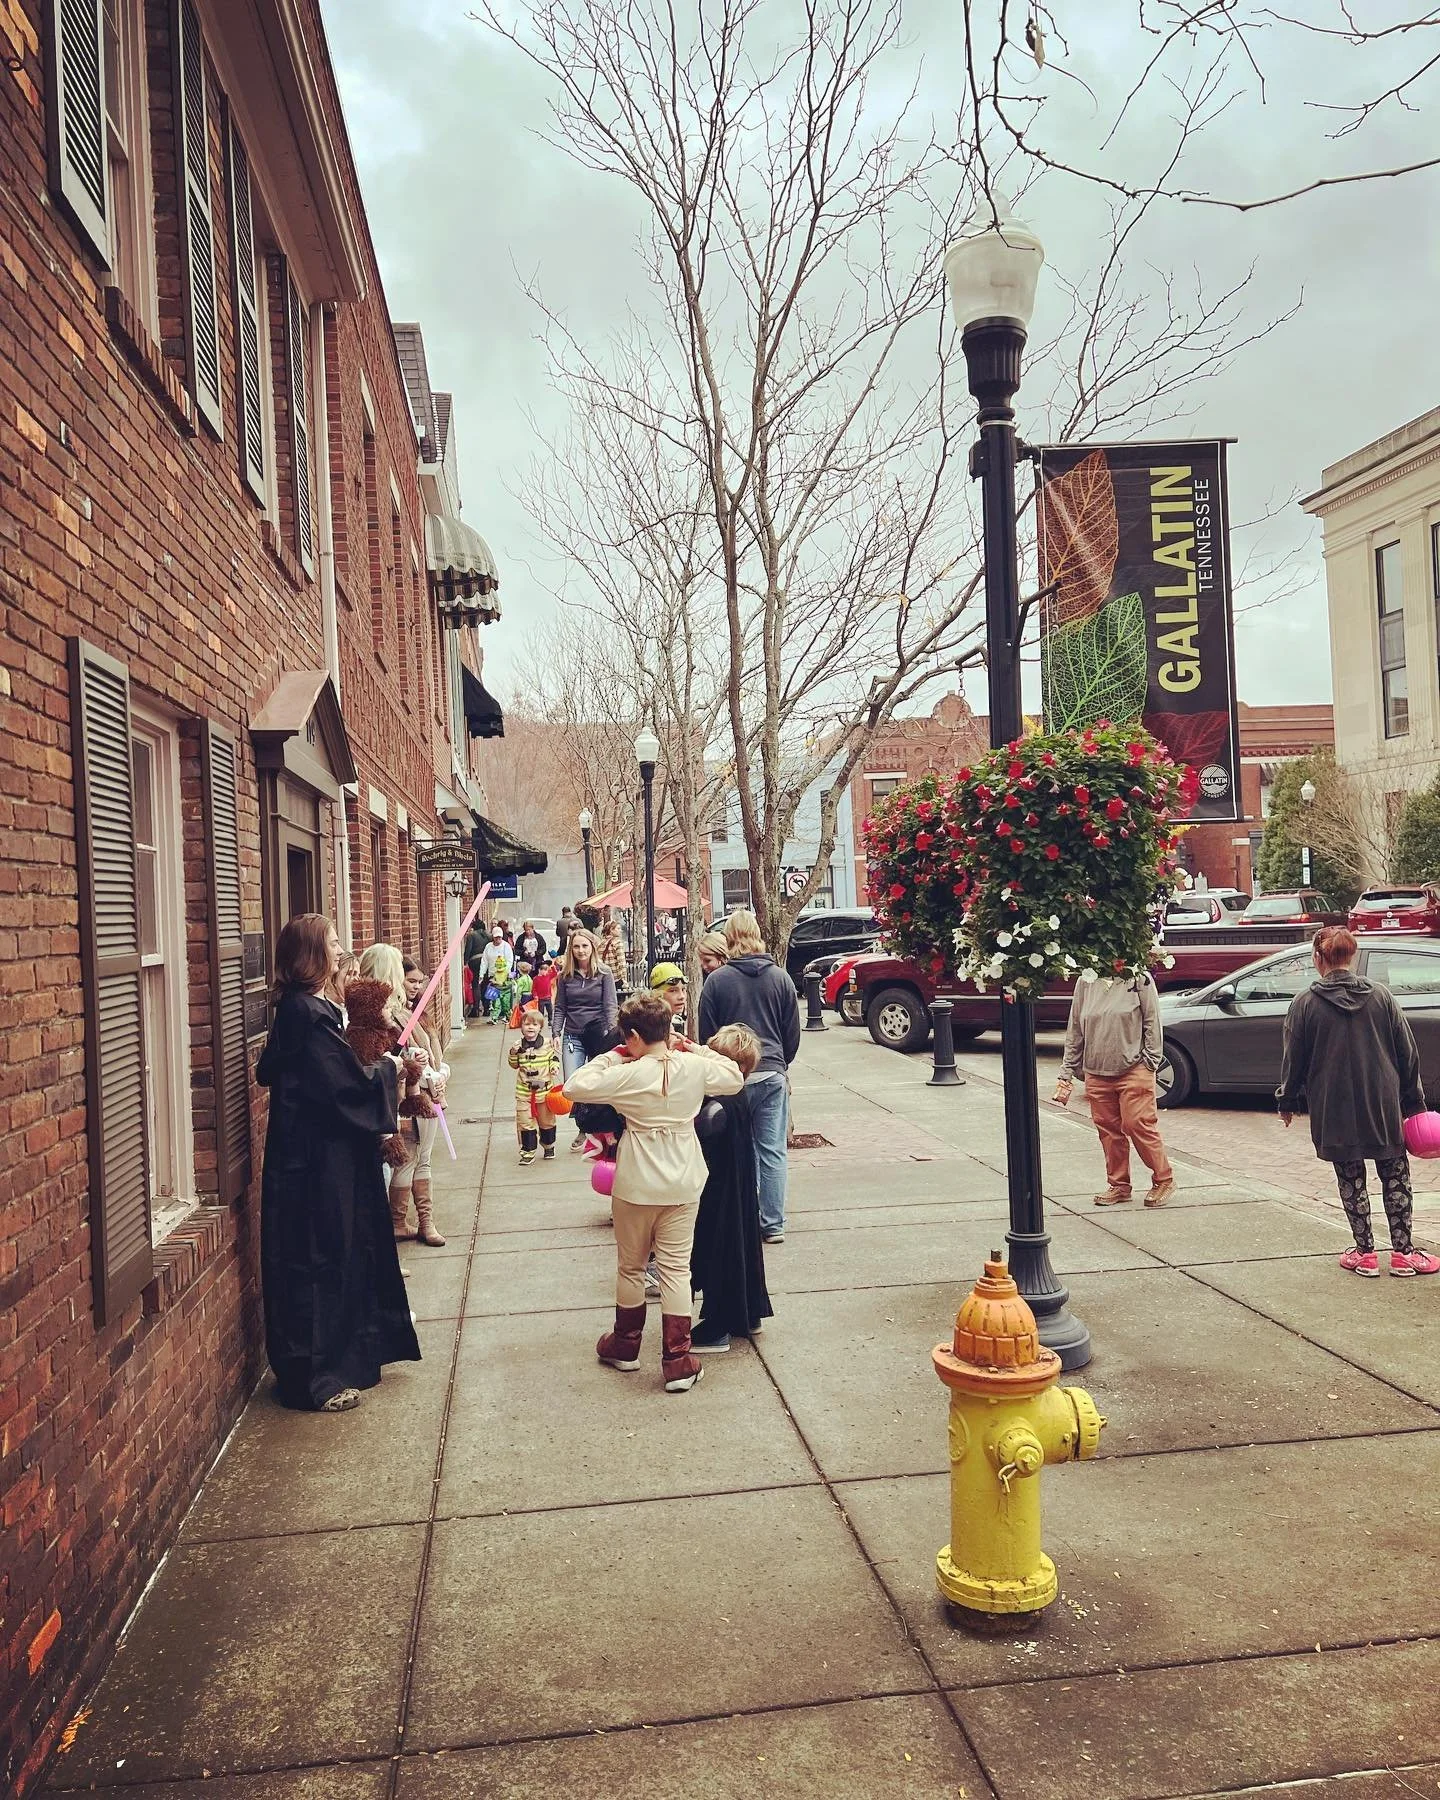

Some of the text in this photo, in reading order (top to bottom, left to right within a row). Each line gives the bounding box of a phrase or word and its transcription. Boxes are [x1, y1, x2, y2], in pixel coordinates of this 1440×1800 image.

[1149, 465, 1202, 693] GALLATIN
[1194, 478, 1211, 593] TENNESSEE
[1200, 777, 1228, 785] GALLATIN
